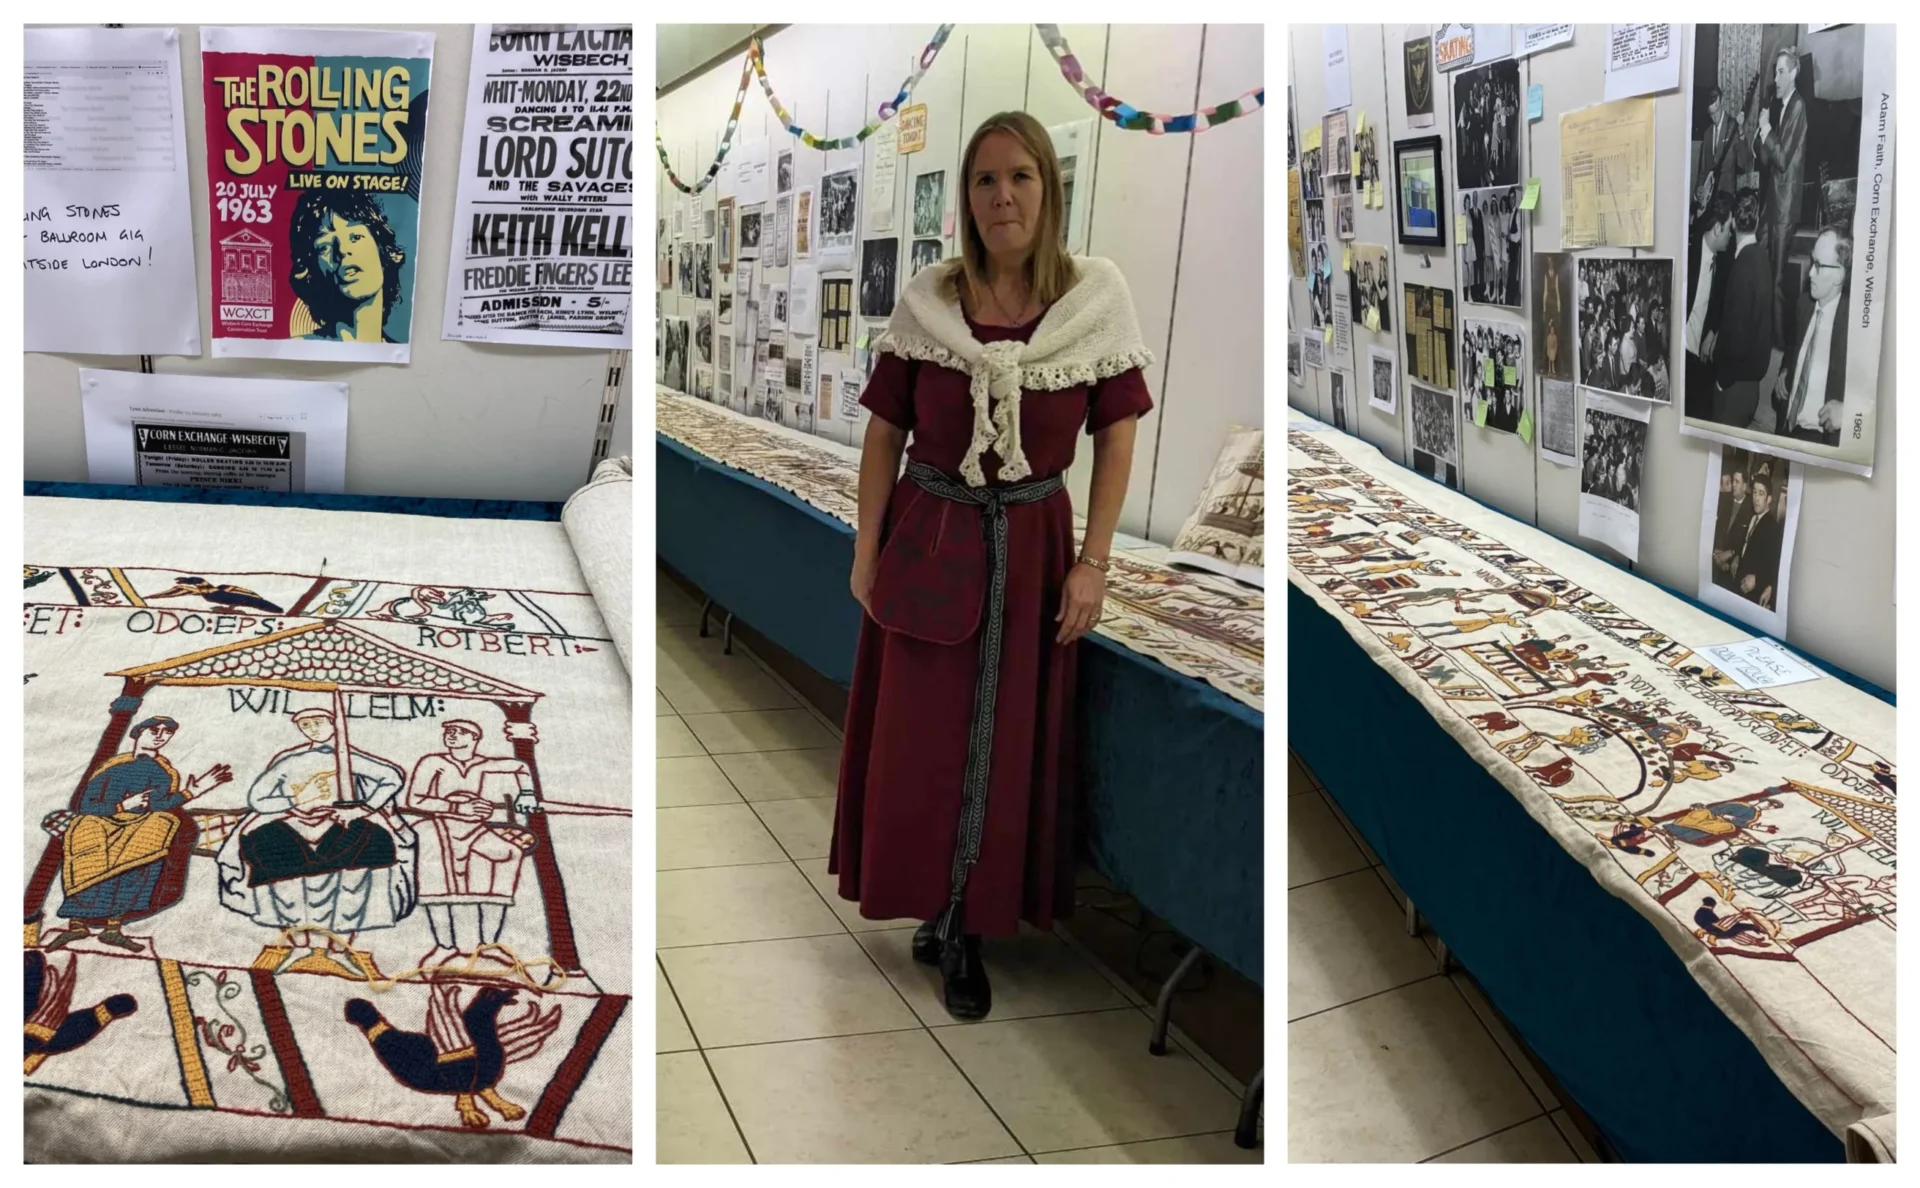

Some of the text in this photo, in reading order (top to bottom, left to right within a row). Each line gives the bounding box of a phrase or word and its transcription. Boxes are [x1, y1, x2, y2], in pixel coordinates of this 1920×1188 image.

[1439, 34, 1473, 63] SKATING
[533, 53, 629, 67] WISBECH
[214, 64, 411, 110] THE ROLLING
[483, 79, 588, 104] WHIT-MONDAY,
[515, 105, 556, 114] DANCING
[486, 115, 632, 133] SCREAMI
[224, 107, 410, 175] STONES
[477, 135, 557, 178] LORD
[215, 181, 278, 199] 20 JULY
[289, 173, 409, 191] LIVE ON STAGE!
[488, 180, 510, 191] AND
[519, 180, 539, 192] THE
[544, 194, 573, 202] WALLY
[578, 195, 608, 203] PETERS
[66, 204, 121, 220] STONES
[216, 197, 273, 224] 1963
[1860, 92, 1890, 329] Adam Faith, Corn Exchange, Wisbech
[40, 230, 108, 243] BALLROOM
[471, 213, 632, 258] KEITH KELL
[464, 262, 632, 290] FREDDIE FNGERS LEE
[222, 307, 271, 319] WCXCT
[1852, 411, 1863, 440] 1962
[150, 429, 276, 446] CORN EXCHANGE WISBECH
